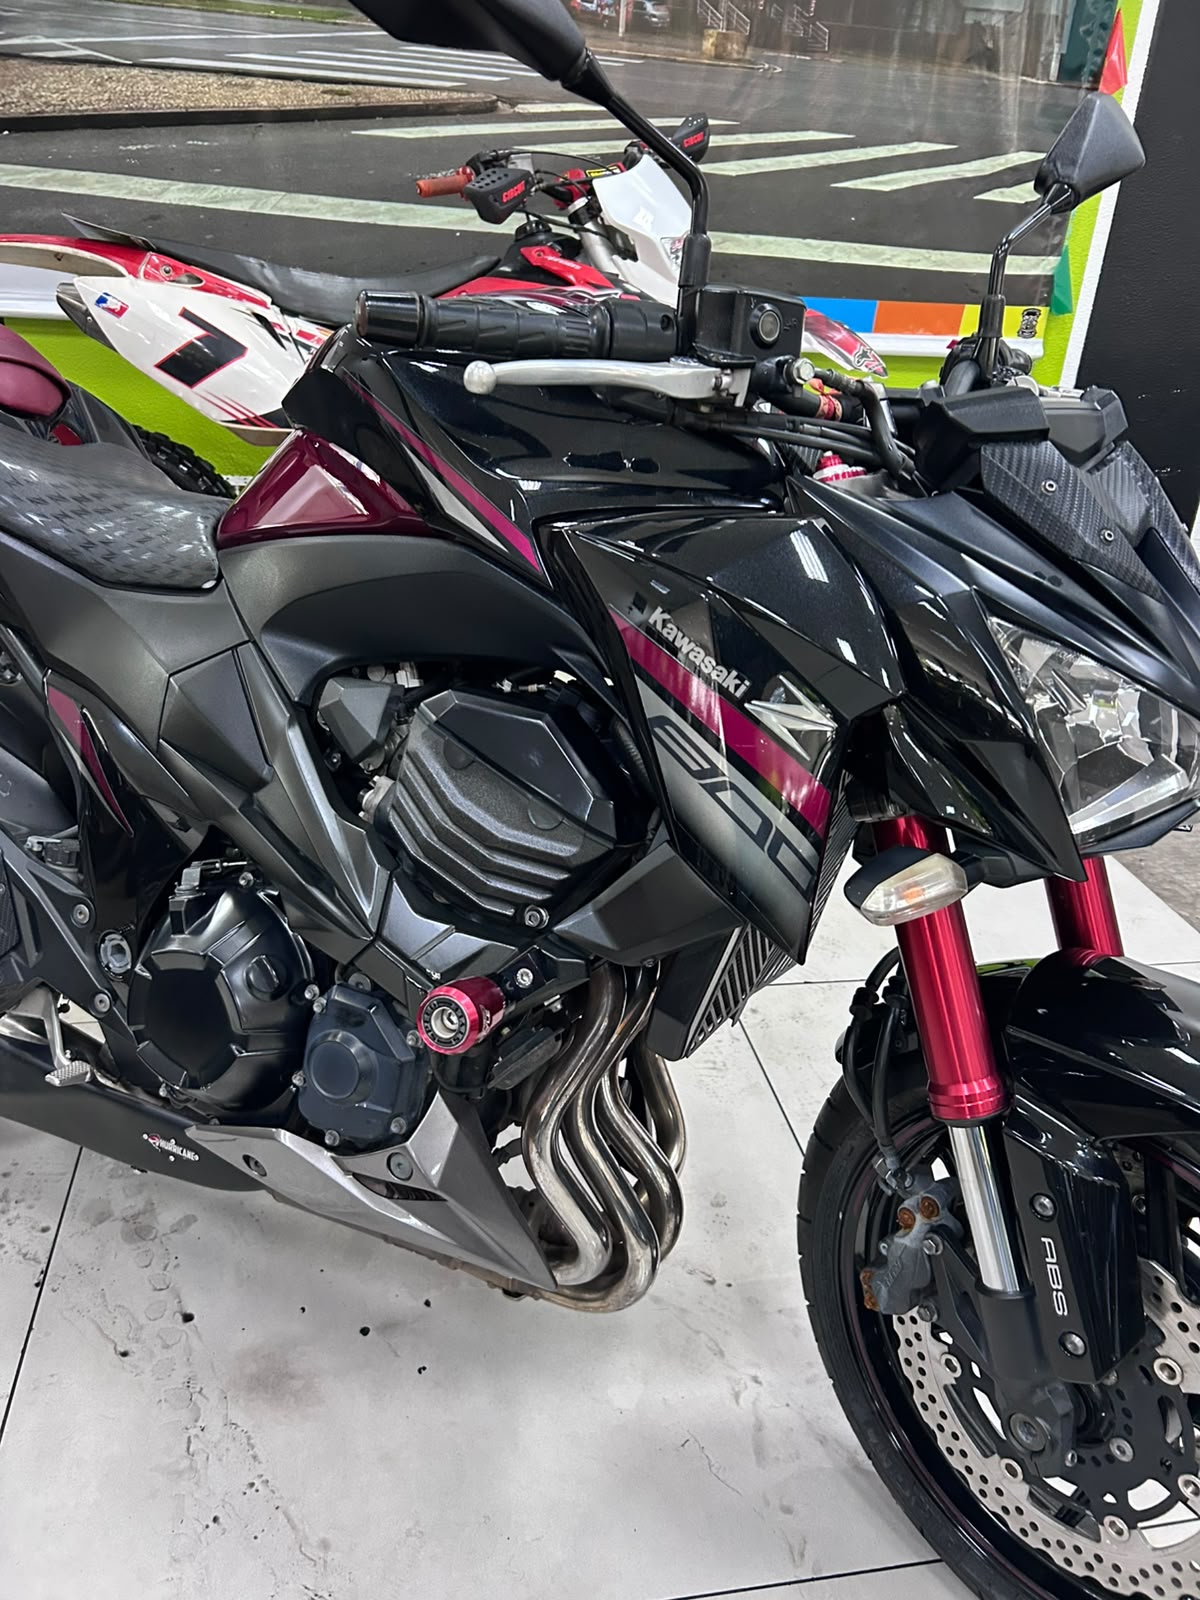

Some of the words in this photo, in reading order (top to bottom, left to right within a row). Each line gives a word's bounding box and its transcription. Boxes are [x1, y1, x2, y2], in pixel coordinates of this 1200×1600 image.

[648, 606, 751, 699] Kawasaki
[647, 715, 818, 893] 800
[159, 1138, 196, 1161] HURRICANE
[1041, 1237, 1068, 1316] ABS
